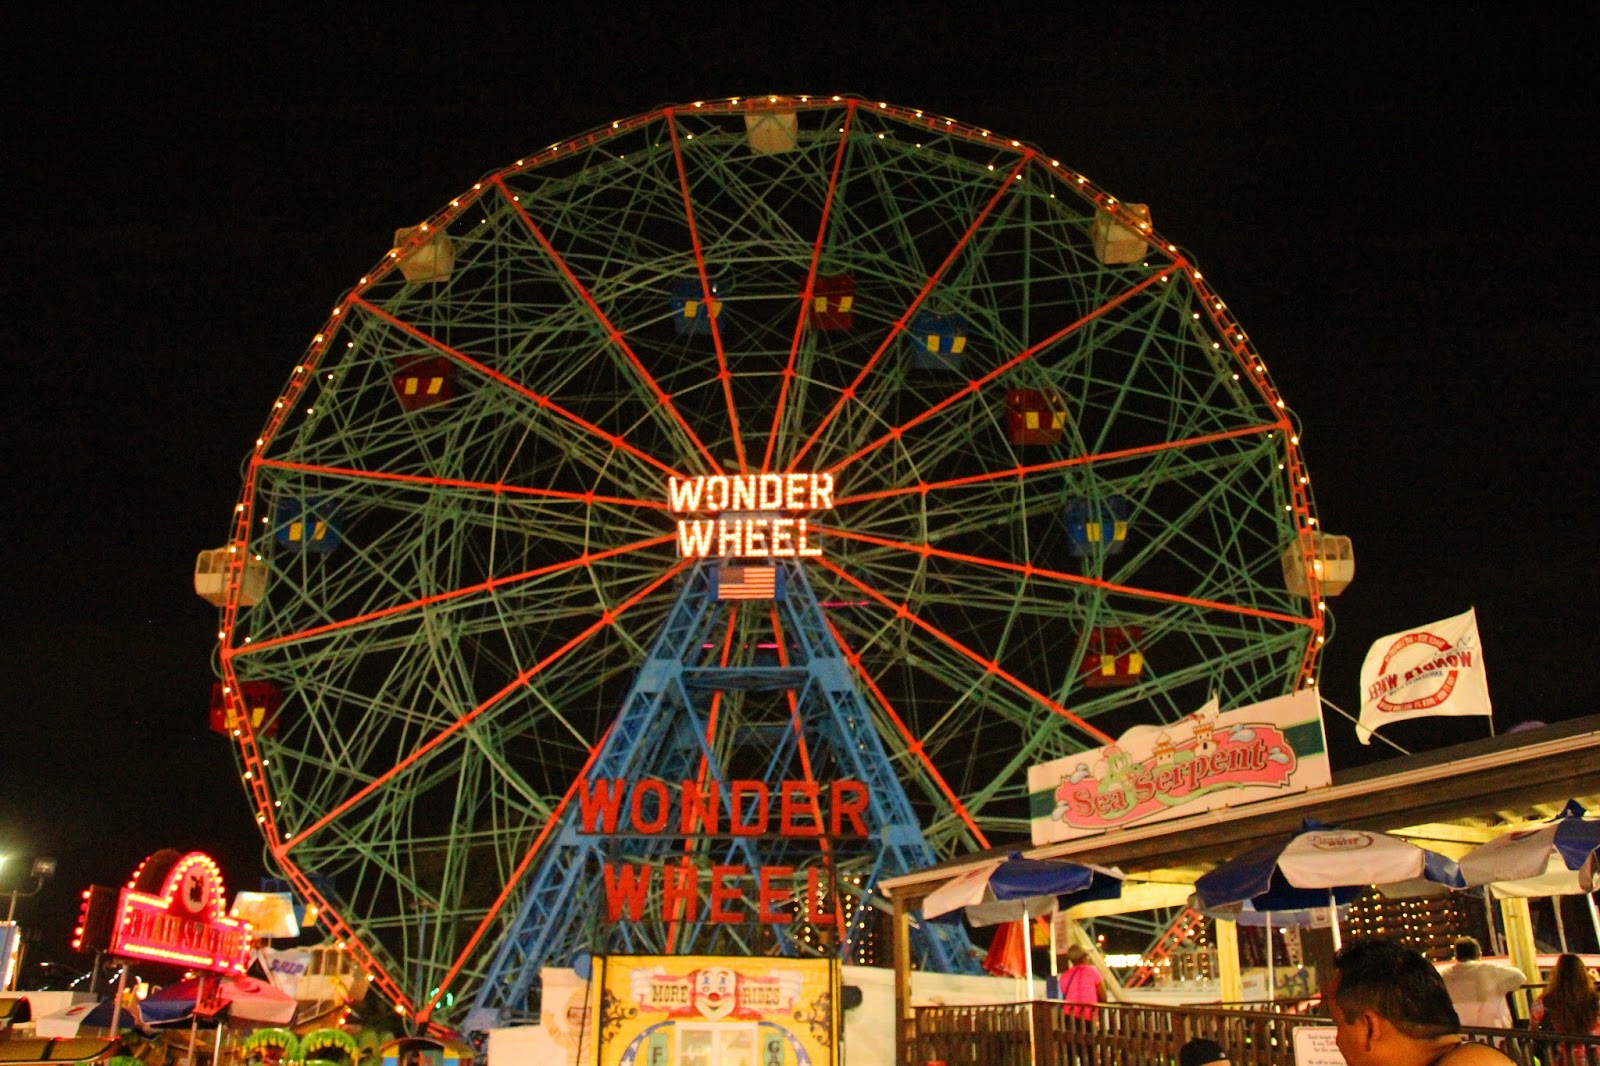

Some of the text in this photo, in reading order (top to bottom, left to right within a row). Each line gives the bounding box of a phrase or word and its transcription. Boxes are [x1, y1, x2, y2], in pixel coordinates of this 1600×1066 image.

[668, 472, 834, 512] WONDER
[677, 517, 823, 558] WHEEL
[1072, 738, 1269, 817] Sea Serpent
[578, 777, 869, 838] WONDER
[604, 863, 837, 924] WHEEL
[651, 983, 781, 1006] MORE RIDES
